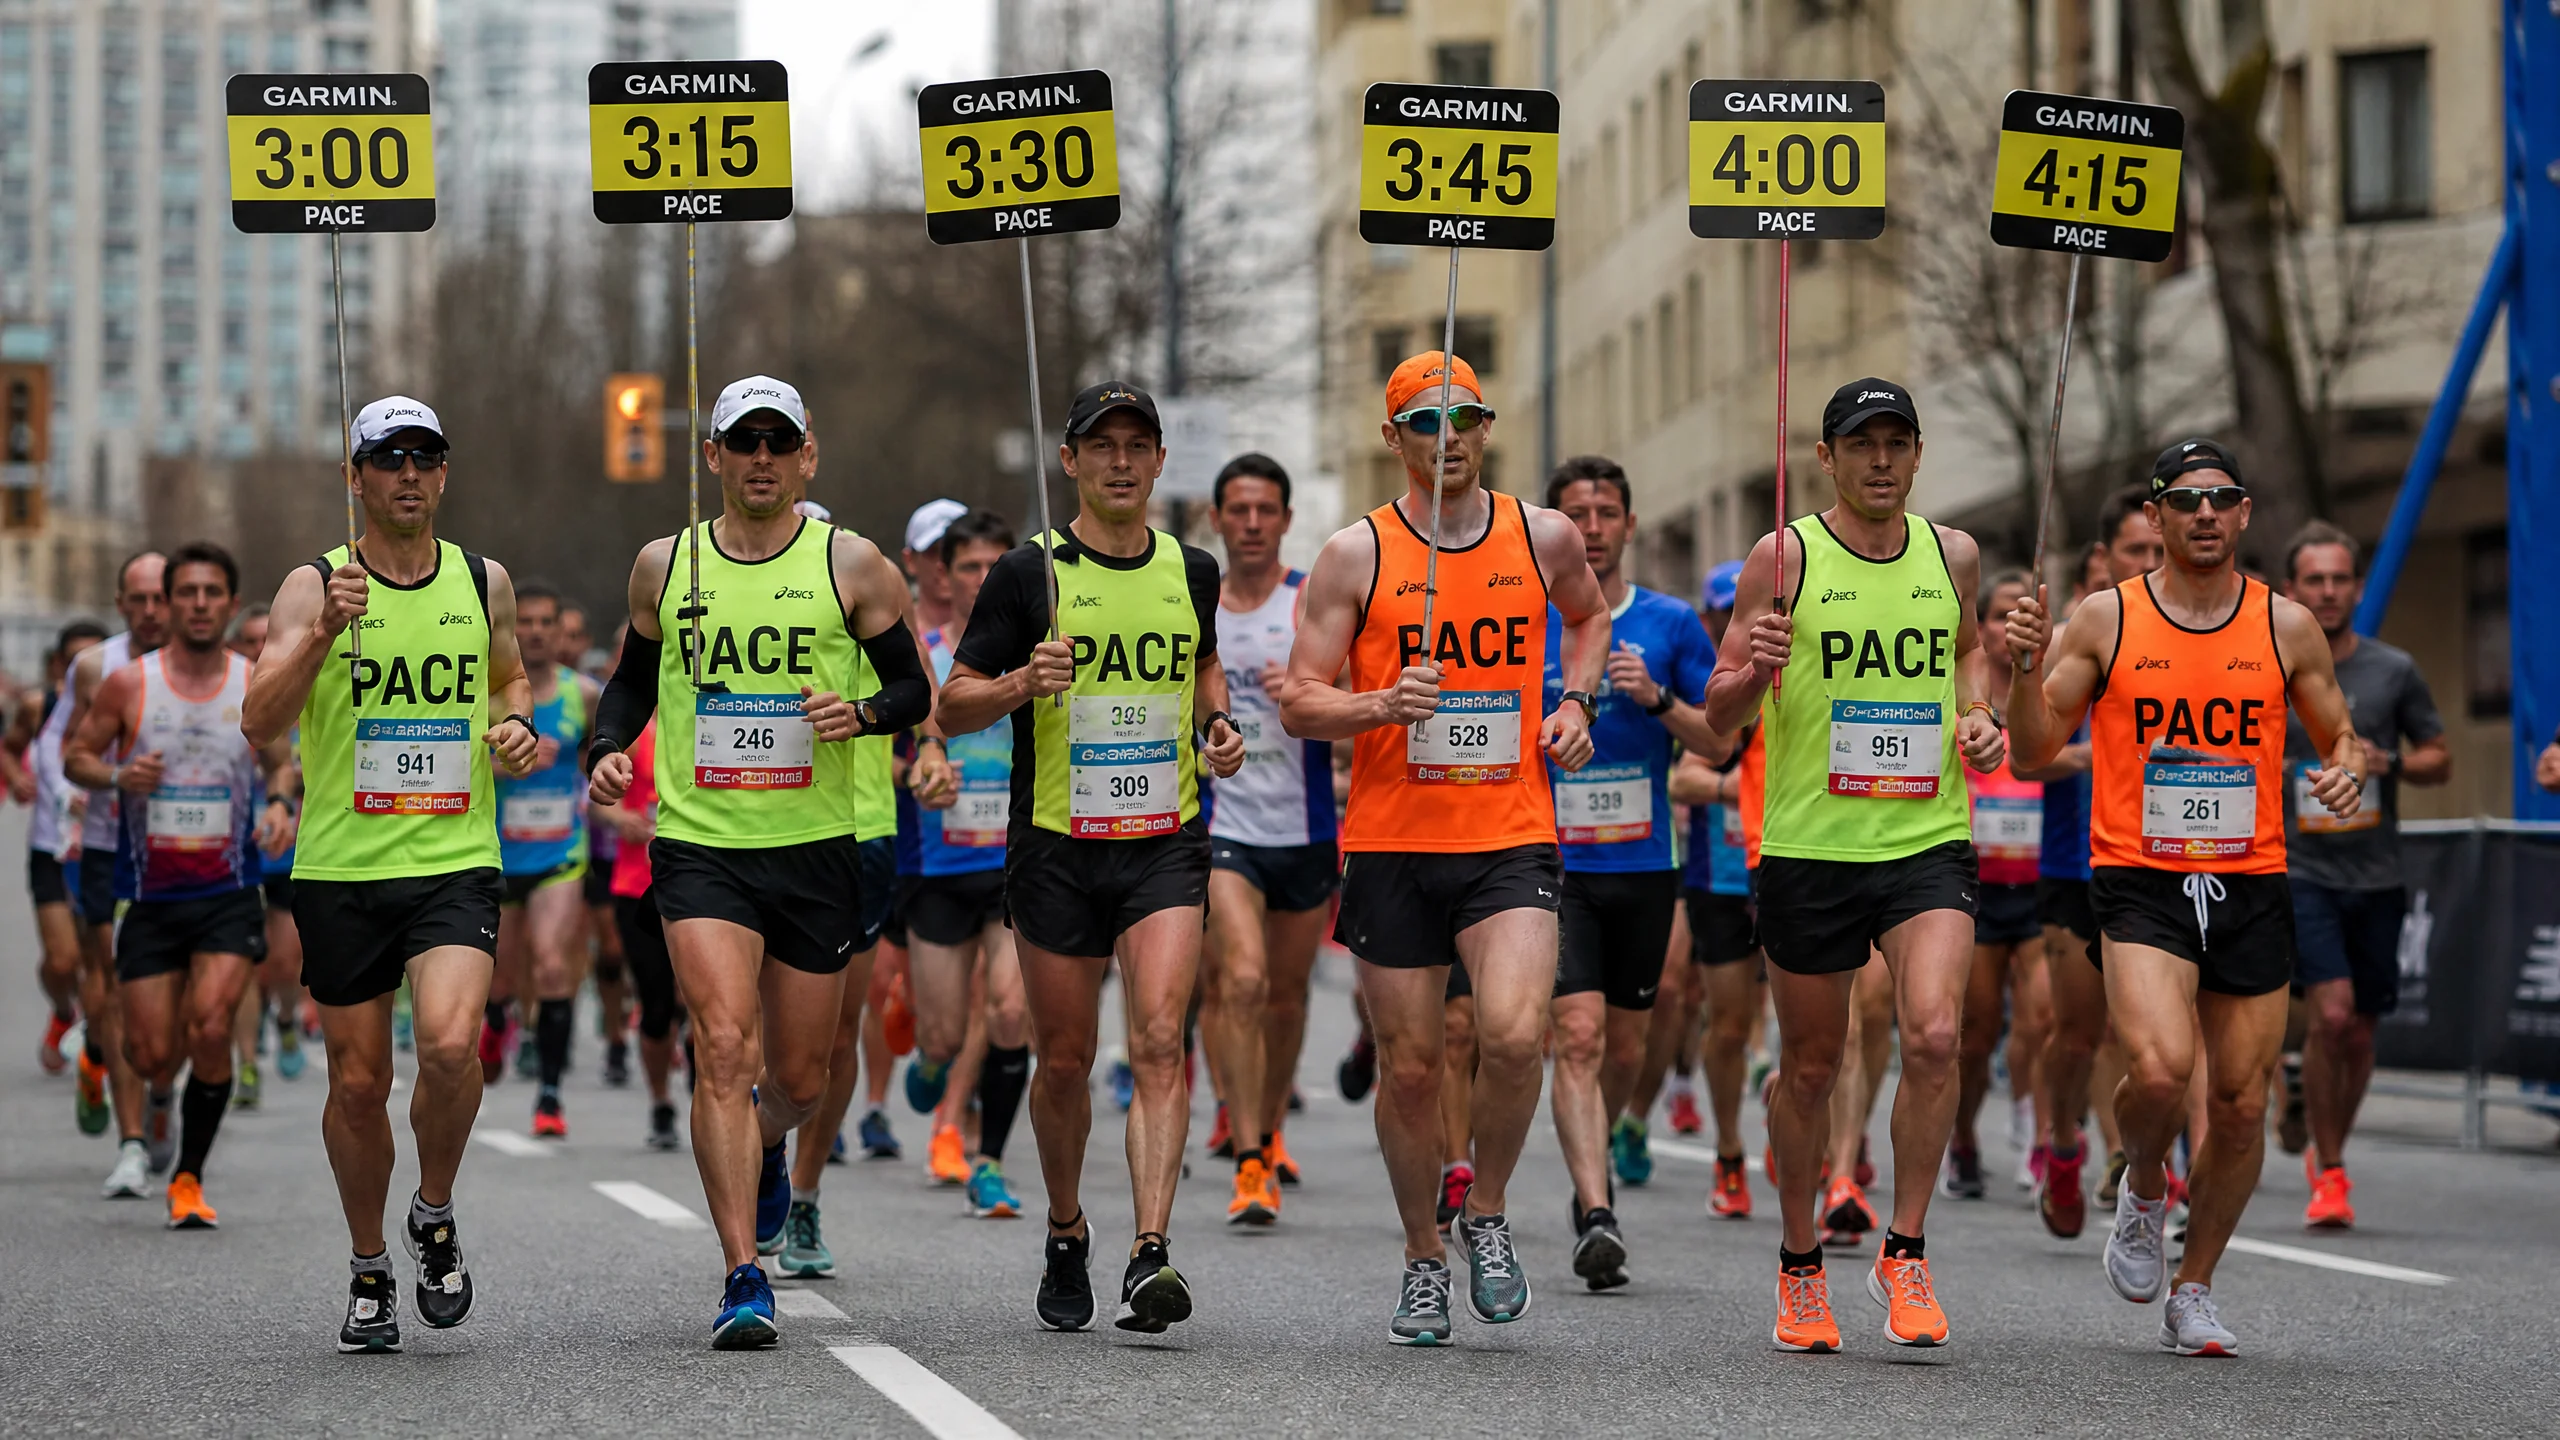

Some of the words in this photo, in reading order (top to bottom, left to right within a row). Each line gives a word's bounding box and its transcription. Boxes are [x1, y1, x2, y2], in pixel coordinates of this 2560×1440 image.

[625, 74, 749, 94] GARMIN
[264, 87, 390, 106] GARMIN
[953, 85, 1074, 114] GARMIN
[1725, 93, 1846, 112] GARMIN
[1400, 98, 1522, 121] GARMIN
[2036, 107, 2149, 136] GARMIN
[256, 127, 408, 189] 3:00
[624, 116, 758, 179] 3:15
[946, 126, 1094, 198] 3:30
[1386, 138, 1531, 205] 3:45
[1713, 134, 1860, 195] 4:00
[2024, 149, 2147, 216] 4:15
[306, 206, 364, 224] PACE
[665, 195, 722, 214] PACE
[995, 208, 1052, 231] PACE
[1429, 220, 1485, 240] PACE
[1759, 212, 1815, 231] PACE
[2054, 226, 2107, 248] PACE
[679, 626, 815, 674] PACE
[1398, 617, 1528, 670] PACE
[1821, 628, 1948, 679] PACE
[1072, 632, 1191, 684] PACE
[352, 654, 477, 707] PACE
[2135, 698, 2263, 746] PACE
[733, 728, 774, 749] 246
[1449, 725, 1488, 746] 528
[1872, 736, 1908, 757] 951
[397, 753, 433, 774] 941
[1110, 775, 1148, 797] 309
[2183, 799, 2219, 820] 261
